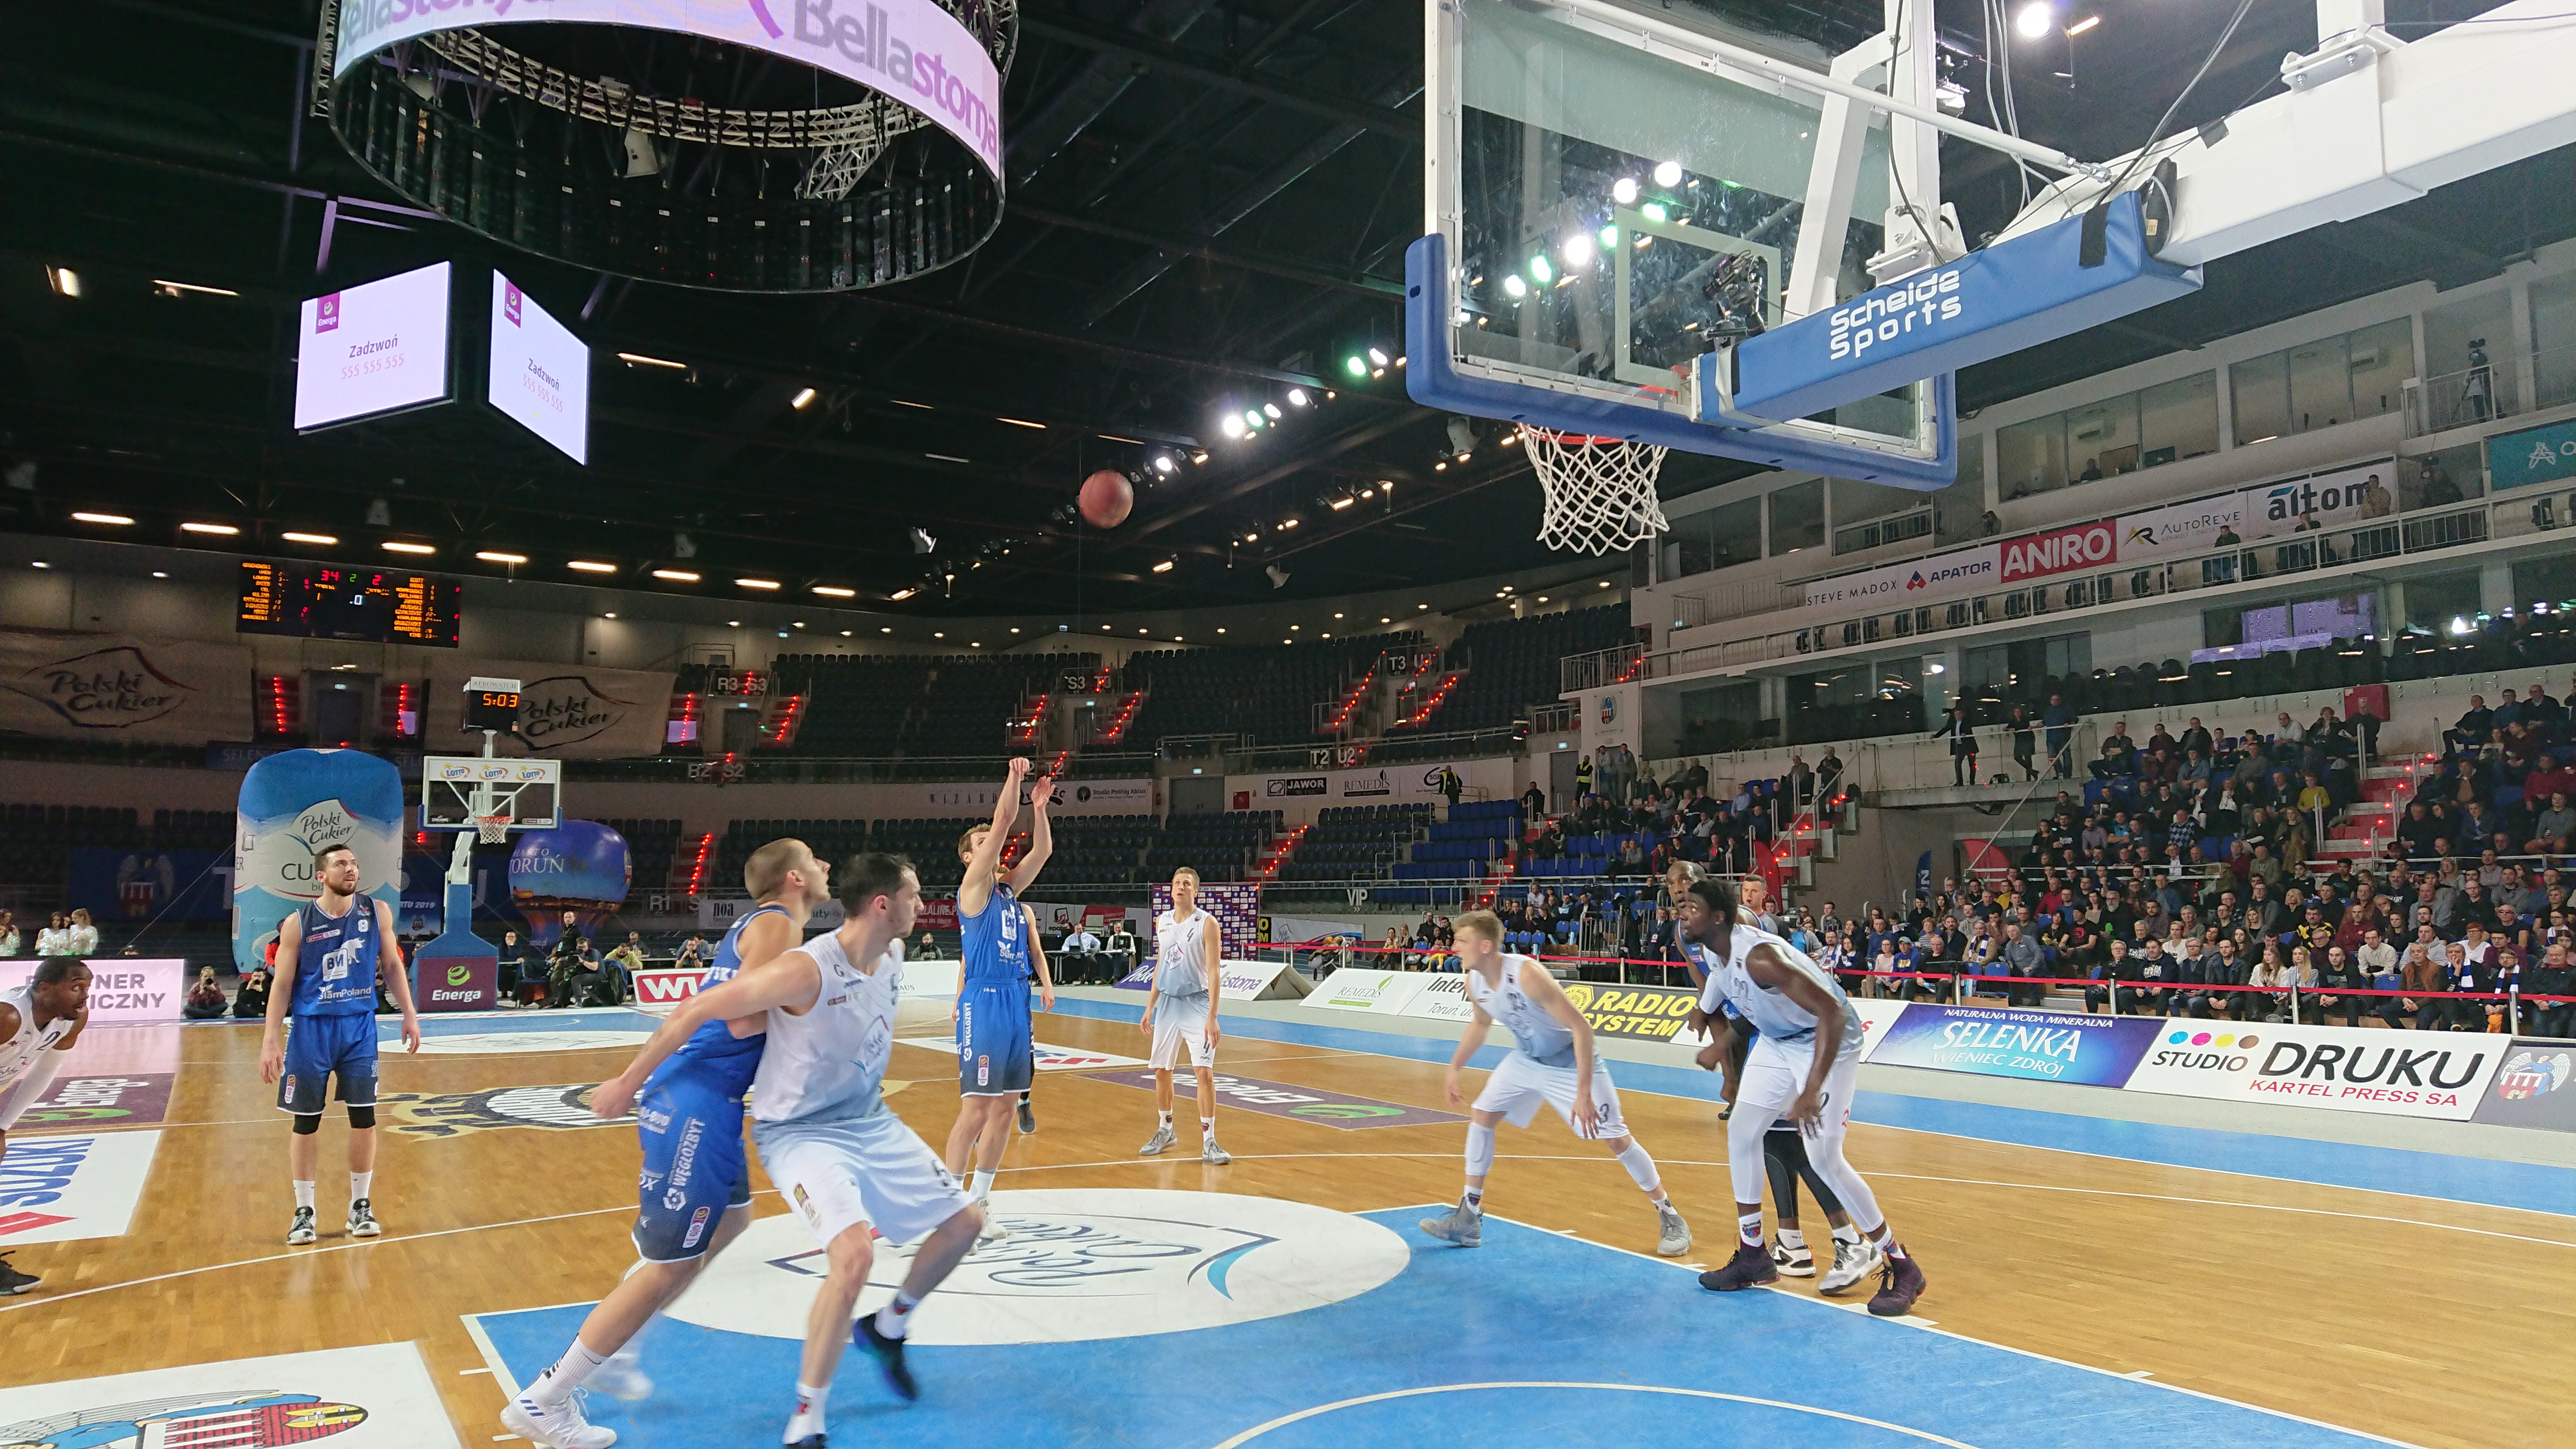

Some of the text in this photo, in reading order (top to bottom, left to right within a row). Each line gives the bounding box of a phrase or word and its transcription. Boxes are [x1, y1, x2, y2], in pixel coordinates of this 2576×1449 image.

[794, 0, 997, 161] Bellastoma
[506, 303, 520, 320] Energa
[1831, 270, 1960, 336] Scheide
[318, 316, 337, 326] Energa
[1831, 296, 1961, 360] Sports
[349, 334, 398, 358] Zadzwoń
[341, 353, 405, 380] 555 555 555
[528, 358, 559, 391] Zadzwoń
[523, 374, 563, 412] 555 555 555
[2003, 528, 2112, 577] ANIRO
[321, 571, 339, 581] 34
[350, 574, 357, 582] 2
[1930, 561, 1991, 583] APATOR
[1807, 579, 1897, 606] STEVE MADOX
[1389, 655, 1406, 670] T3
[44, 670, 142, 694] Polski
[718, 677, 738, 691] R3
[747, 679, 767, 691] S3
[1068, 677, 1085, 689] S3
[67, 692, 171, 711] Cukier
[483, 693, 518, 708] 5:03
[525, 712, 607, 737] Cukier
[1311, 750, 1328, 764] T2
[1338, 749, 1356, 763] U2
[723, 763, 744, 777] S2
[1287, 778, 1325, 790] JAWOR
[1344, 777, 1390, 791] REMEDIS
[301, 811, 341, 834] Polski
[309, 826, 352, 844] Cukier
[650, 895, 670, 911] R1
[1347, 889, 1368, 906] VIP
[714, 902, 734, 916] noa
[358, 919, 368, 932] 8
[1187, 928, 1194, 942] 4
[432, 989, 481, 1003] Energa
[1338, 986, 1384, 998] REMEDIS
[1428, 1002, 1457, 1017] Toruń,
[1592, 991, 1697, 1017] RADIO
[1583, 1013, 1683, 1037] SYSTEM
[1945, 1009, 2113, 1027] NATURALNA WODA MINERALNA
[1933, 1021, 2082, 1063] SELENKA
[1933, 1052, 2064, 1078] WIENIEC ZDRÓJ
[2152, 1050, 2248, 1072] STUDIO
[2258, 1041, 2485, 1089] DRUKU
[2250, 1079, 2458, 1106] KARTEL PRESS SA
